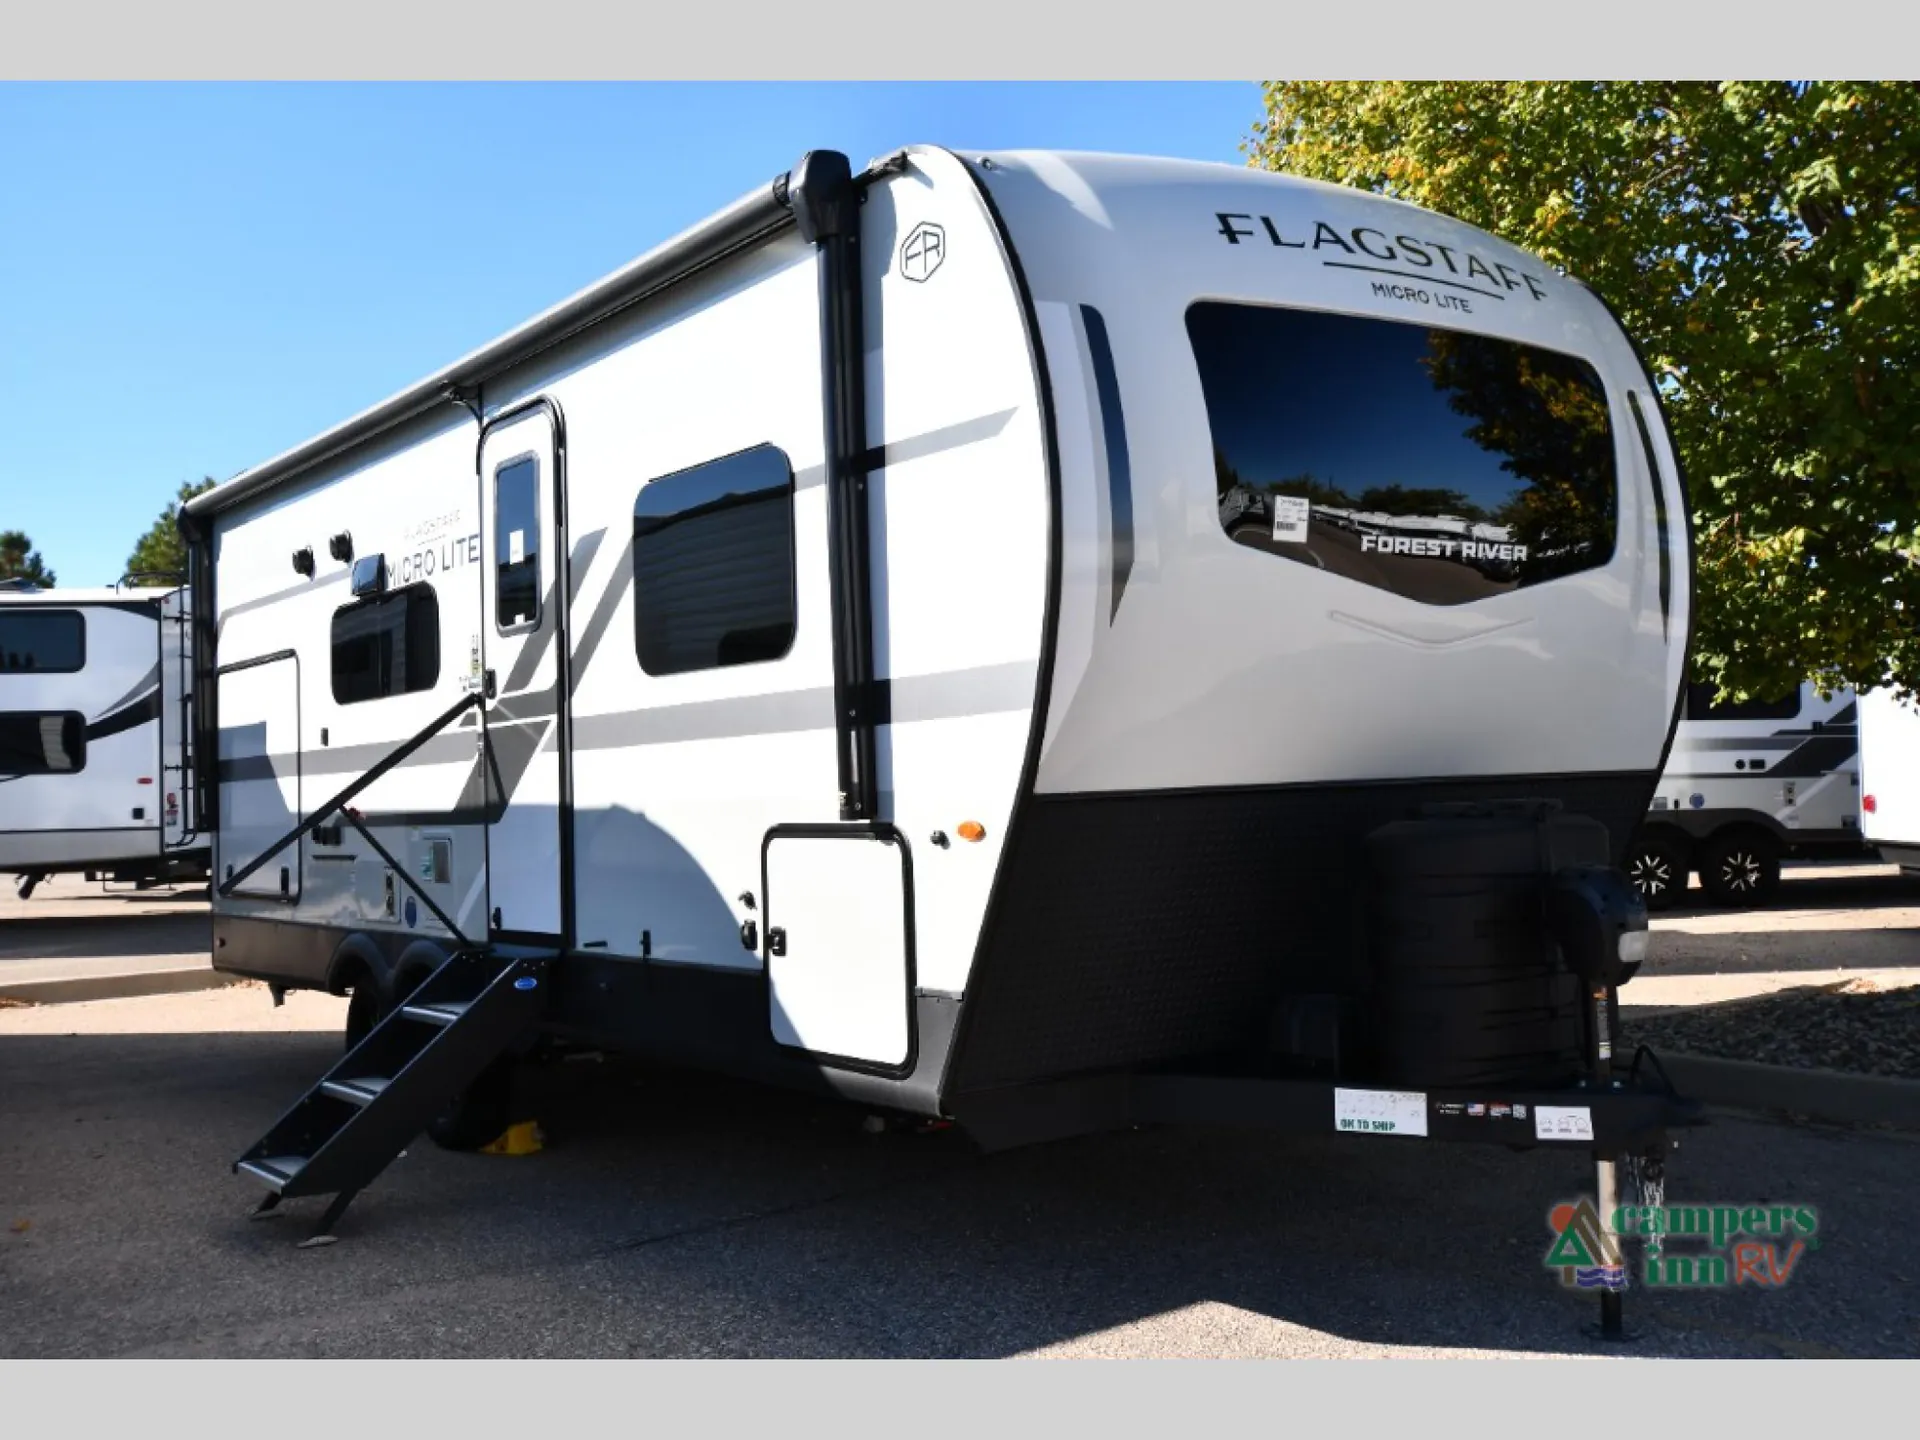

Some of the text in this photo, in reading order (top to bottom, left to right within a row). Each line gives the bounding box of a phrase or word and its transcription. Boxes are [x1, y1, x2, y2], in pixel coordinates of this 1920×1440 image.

[1215, 212, 1548, 301] FLAGSTAFF
[1371, 282, 1473, 314] MICRO LITE
[386, 534, 480, 587] MICRO LITE
[1361, 535, 1528, 562] FOREST RIVER
[1340, 1118, 1396, 1131] OK TO SHIP
